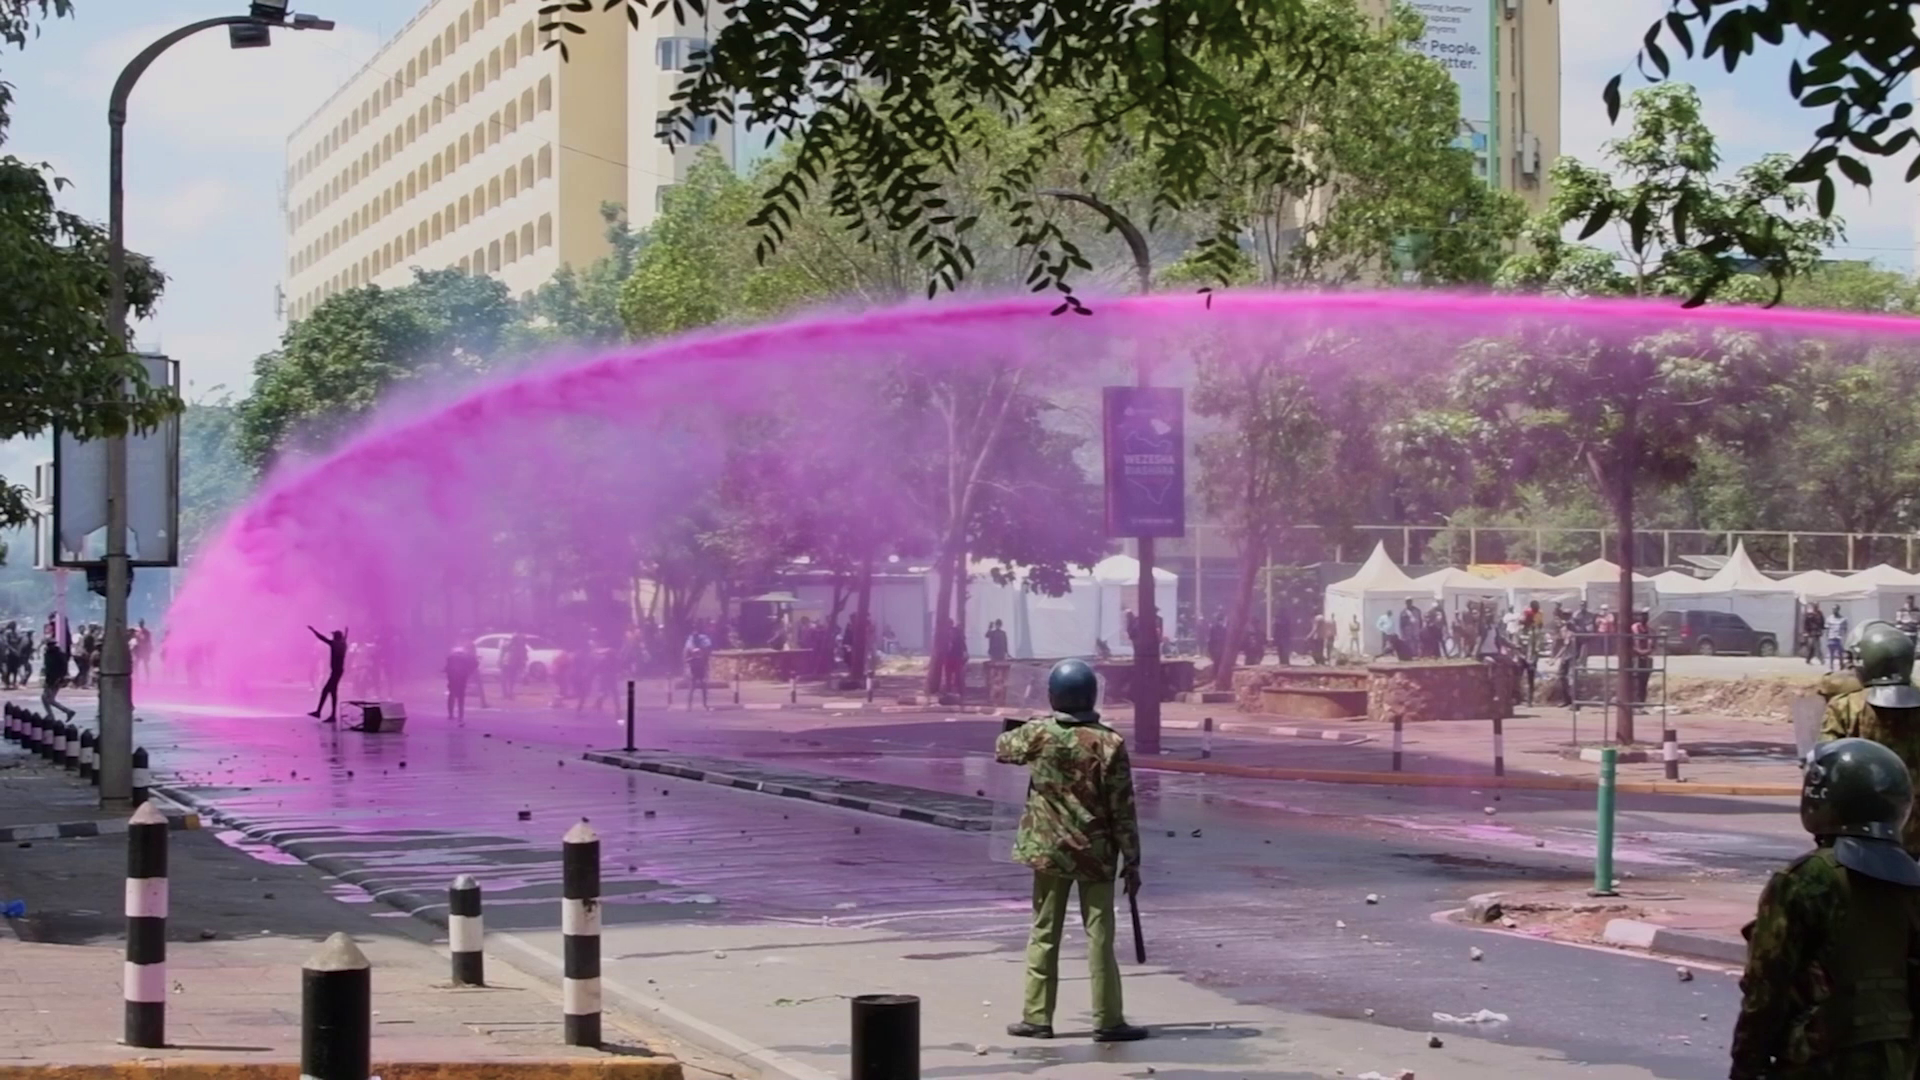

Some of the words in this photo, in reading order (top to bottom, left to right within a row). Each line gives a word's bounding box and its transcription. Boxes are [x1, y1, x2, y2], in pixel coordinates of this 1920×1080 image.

[1431, 15, 1461, 24] spaces
[1431, 40, 1481, 56] People.
[1123, 454, 1175, 464] WEZESHA
